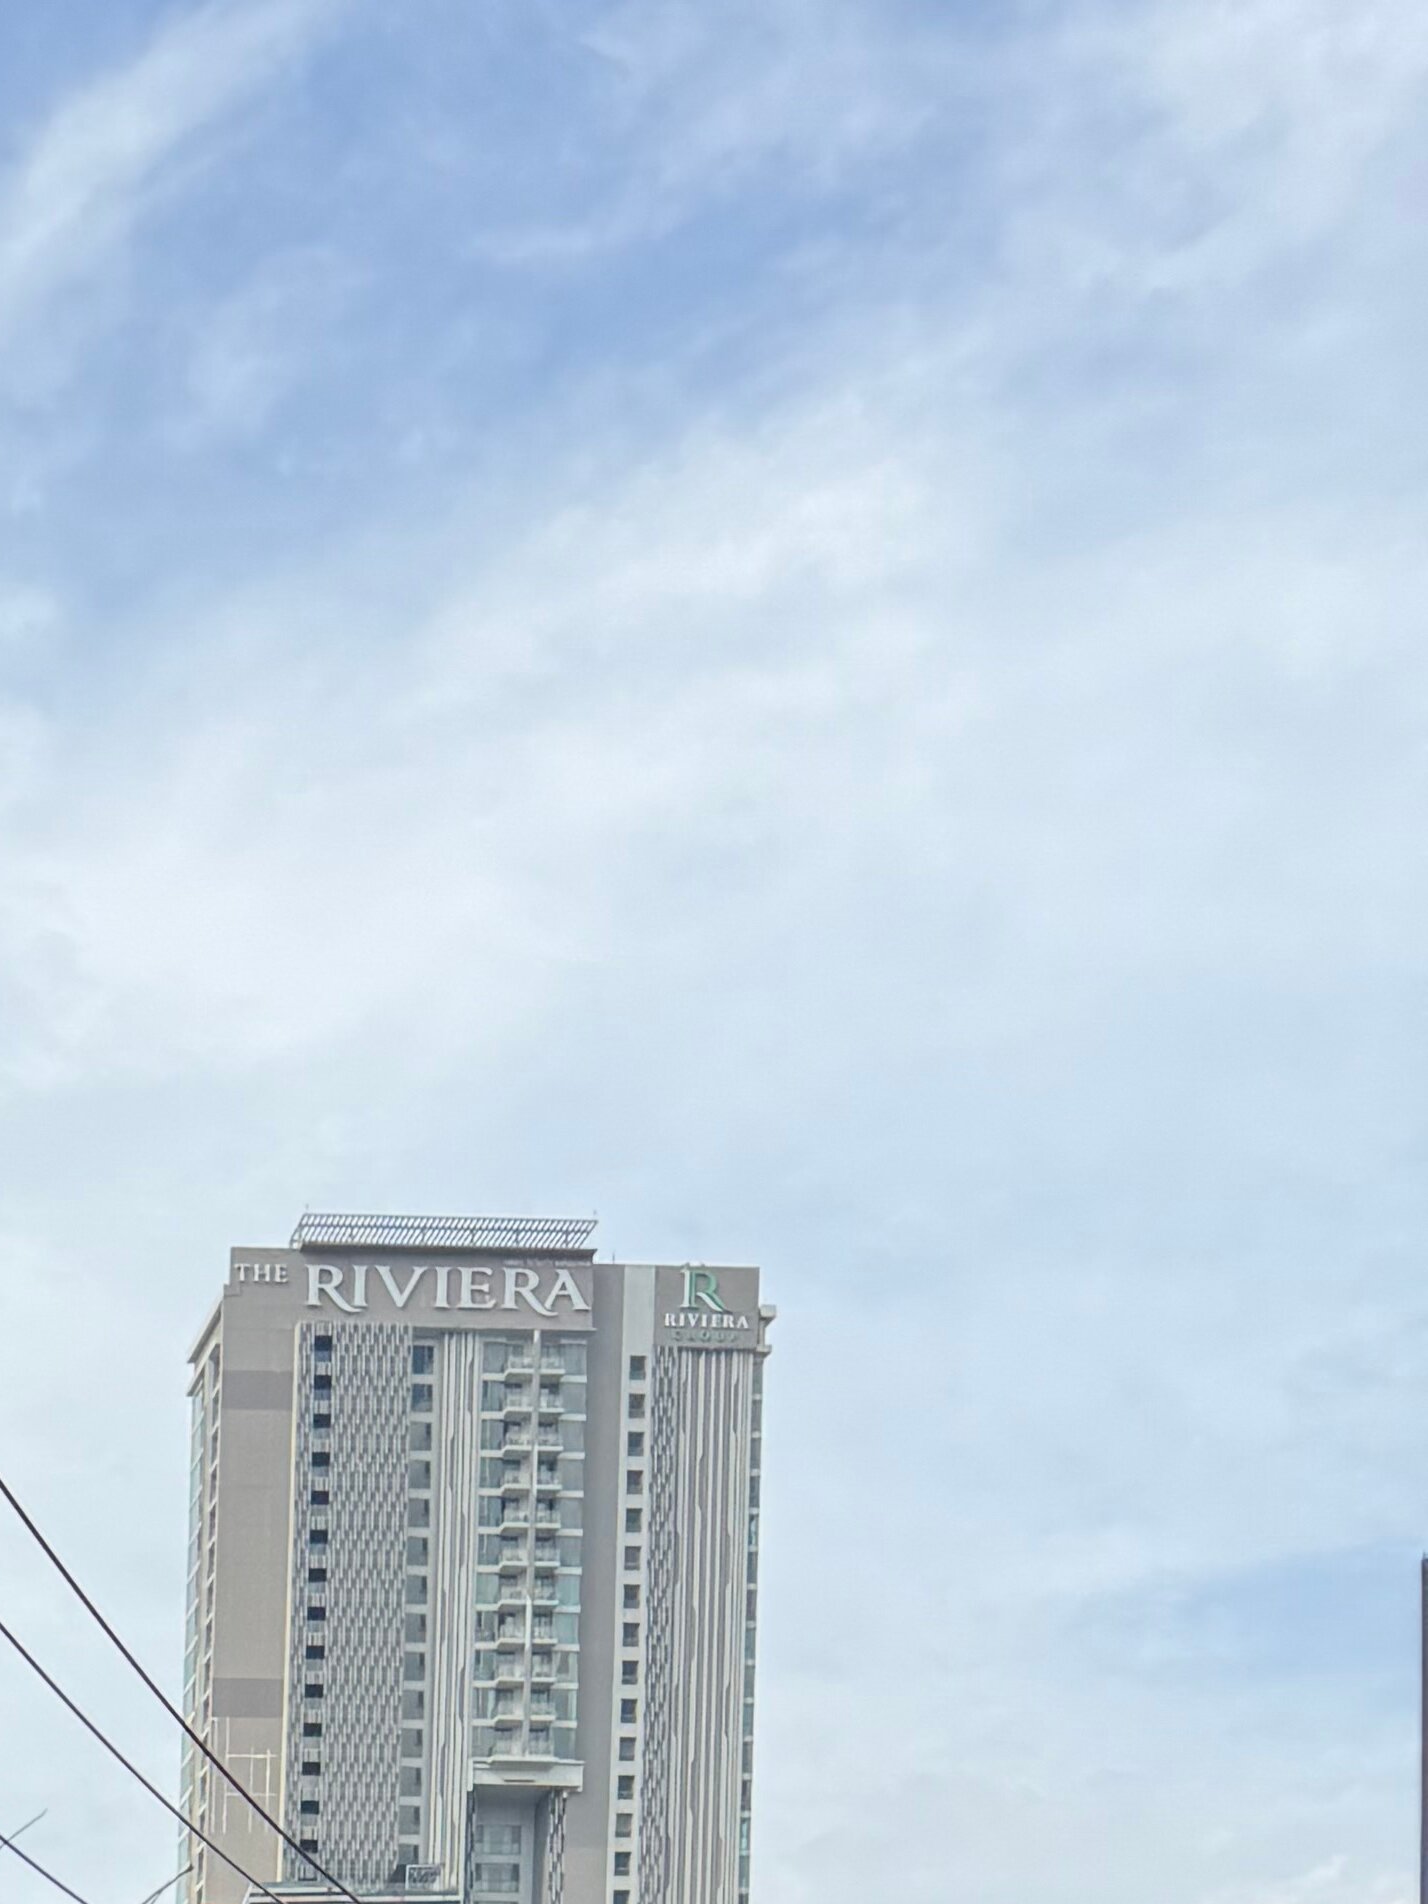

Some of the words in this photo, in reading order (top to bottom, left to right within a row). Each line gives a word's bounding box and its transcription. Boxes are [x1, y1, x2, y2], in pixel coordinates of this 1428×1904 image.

[233, 1262, 288, 1284] THE
[304, 1263, 591, 1316] RIVIERA
[664, 1312, 750, 1330] RIVIERA
